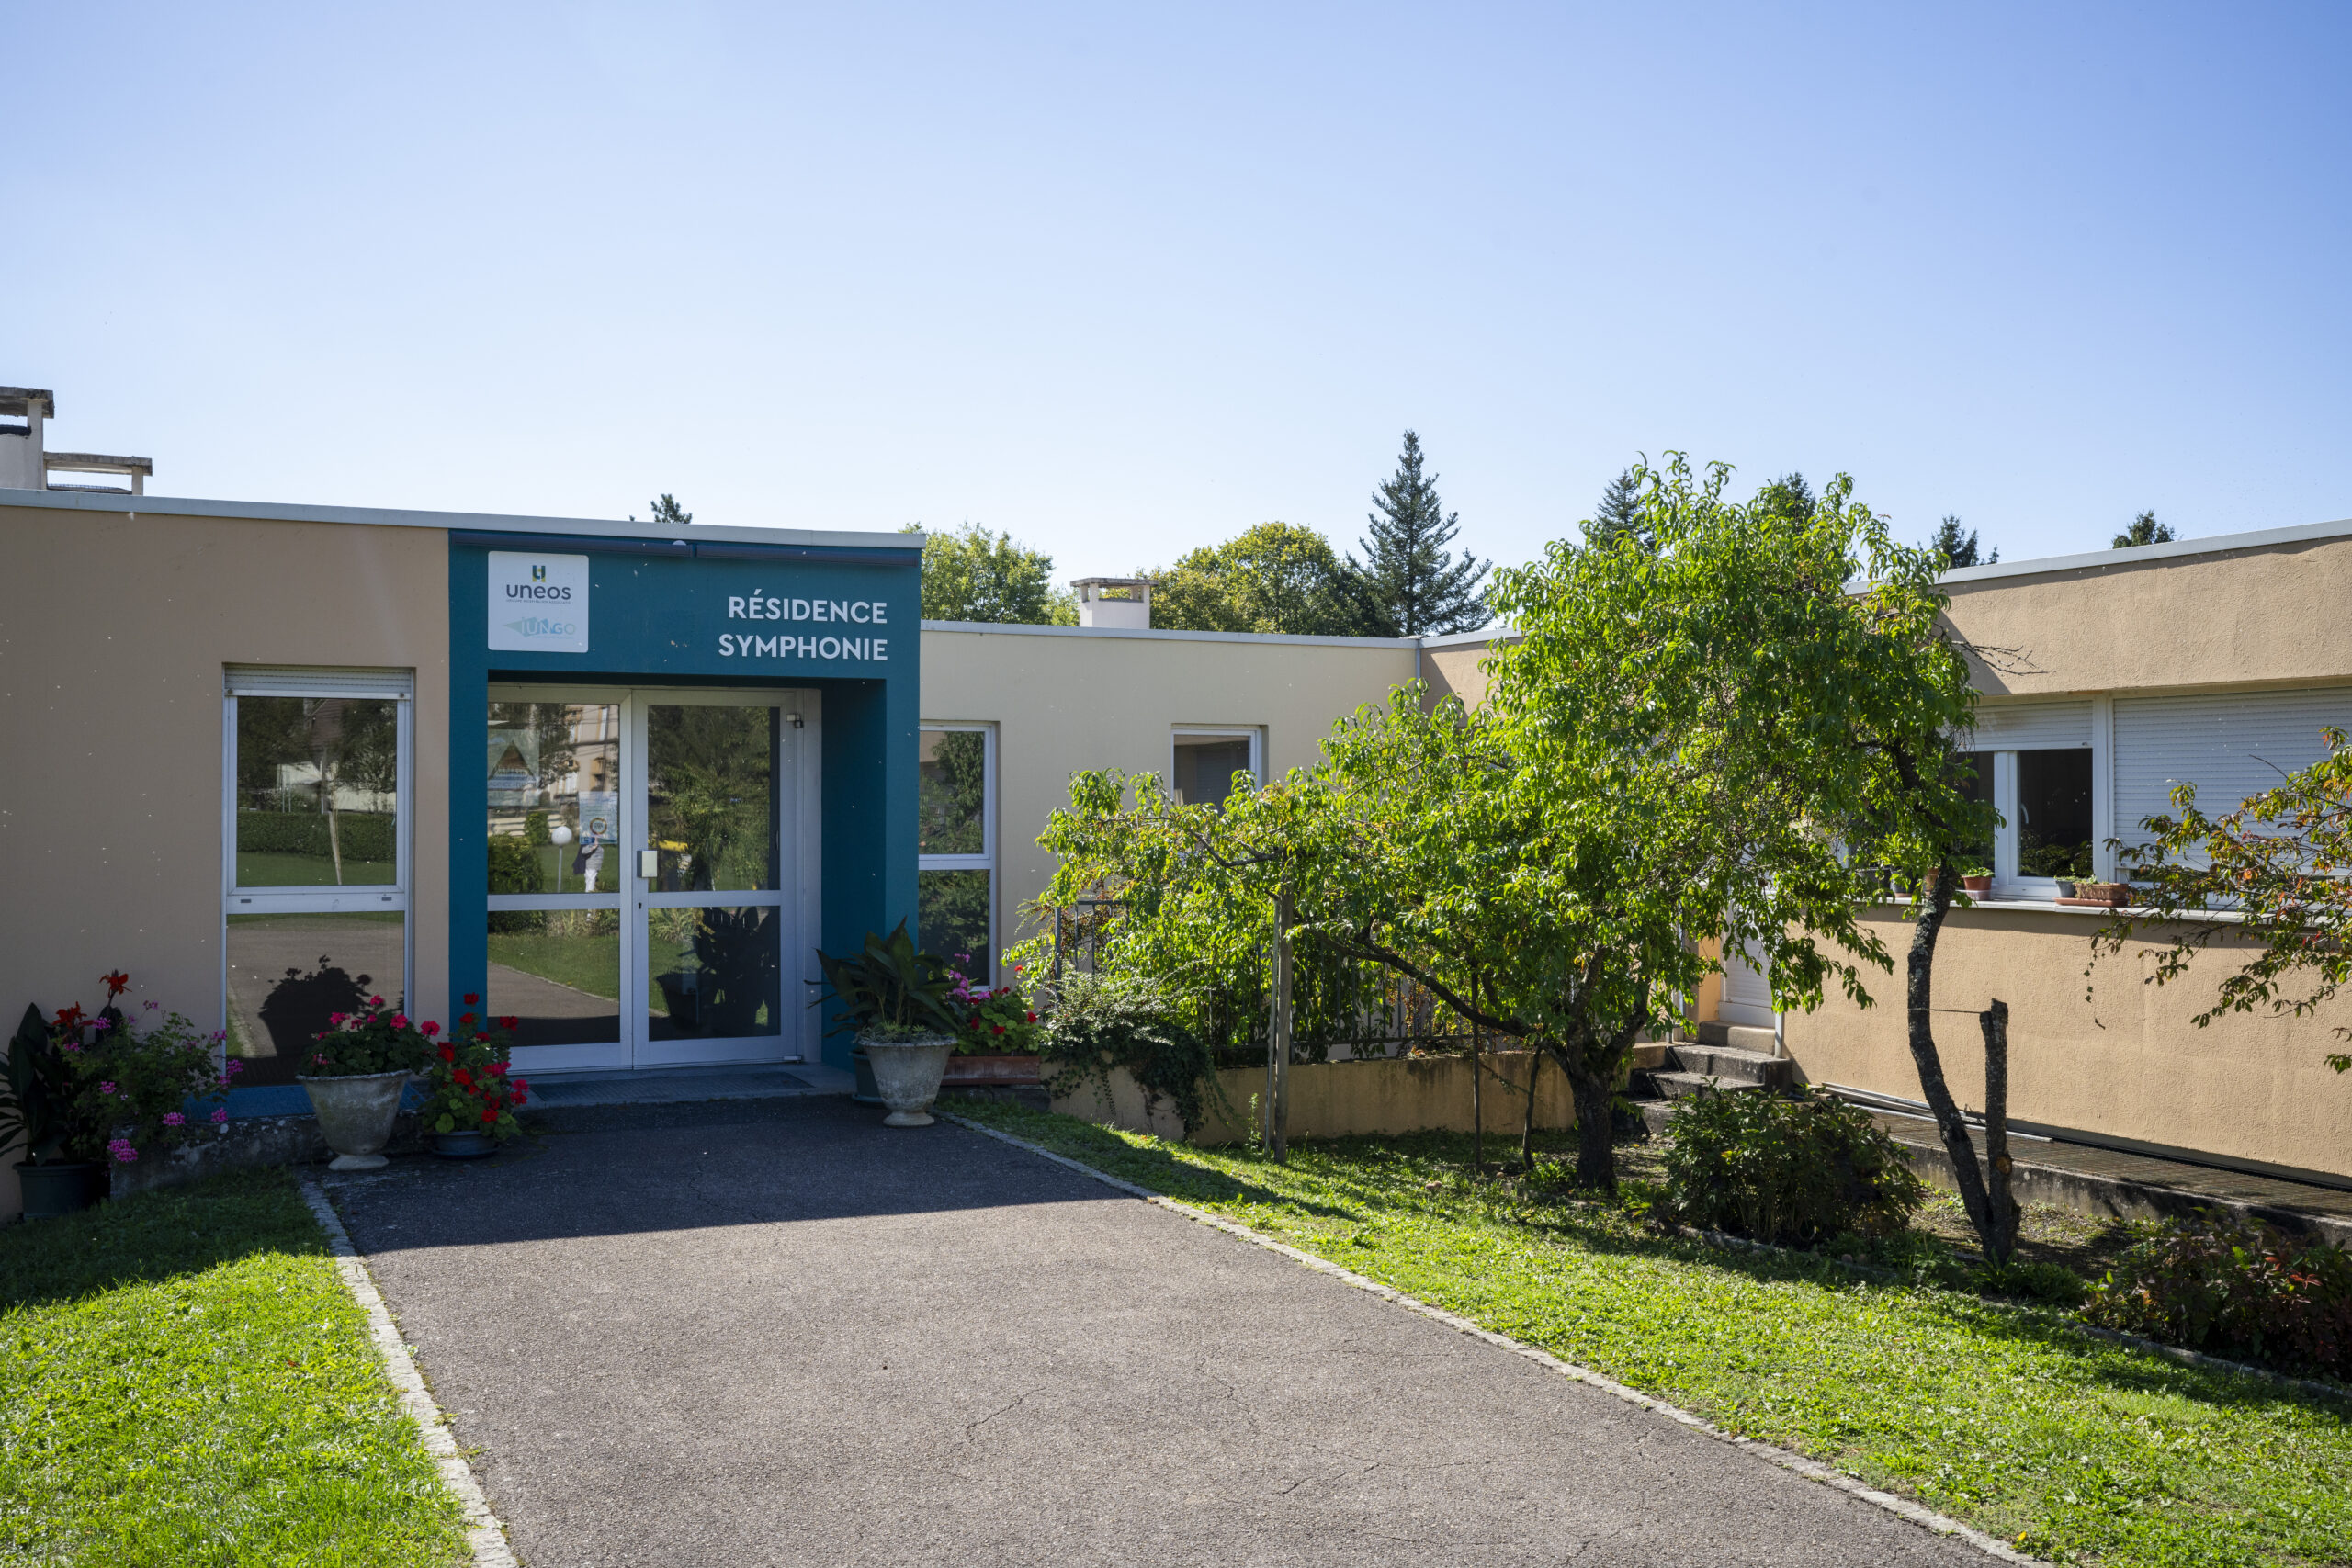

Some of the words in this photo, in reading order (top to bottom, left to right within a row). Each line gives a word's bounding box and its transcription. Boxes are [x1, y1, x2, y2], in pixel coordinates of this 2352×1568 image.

[506, 584, 571, 600] uneos
[729, 589, 888, 624] RÉSIDENCE
[718, 634, 888, 661] SYMPHONIE
